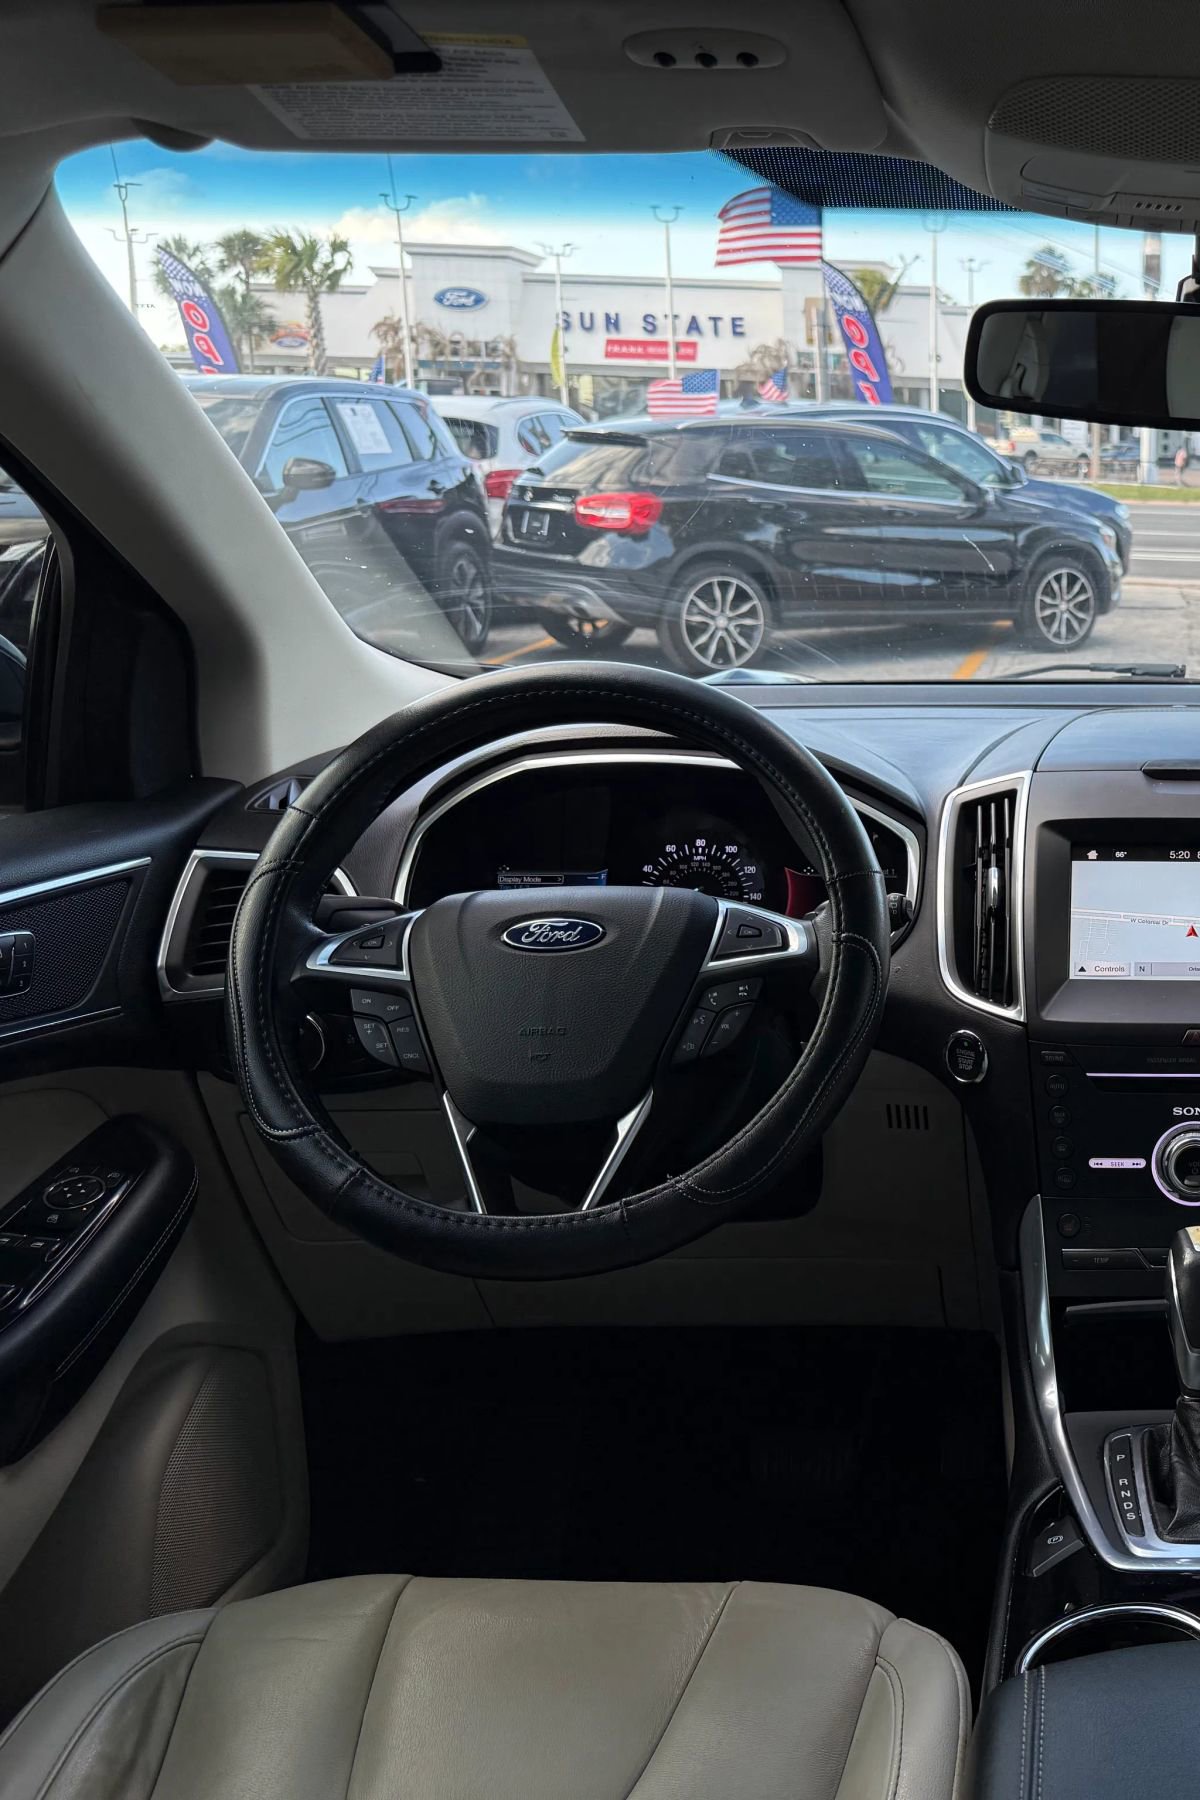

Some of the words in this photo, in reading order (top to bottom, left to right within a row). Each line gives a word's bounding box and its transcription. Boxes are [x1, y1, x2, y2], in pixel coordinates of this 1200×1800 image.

[556, 311, 621, 334] SUN
[642, 313, 746, 337] STATE
[696, 839, 706, 847] 80
[665, 844, 676, 853] 60
[725, 845, 738, 853] 100
[1169, 850, 1190, 859] 5:20
[642, 865, 653, 873] 40
[743, 866, 756, 874] 120
[749, 892, 762, 901] 140
[521, 921, 581, 943] Ford
[1094, 965, 1125, 973] Controls
[1093, 1256, 1110, 1264] TEMP
[1116, 1454, 1126, 1462] P
[1118, 1478, 1128, 1486] R
[1121, 1490, 1131, 1498] N
[1123, 1502, 1133, 1510] D
[1126, 1512, 1136, 1520] S
